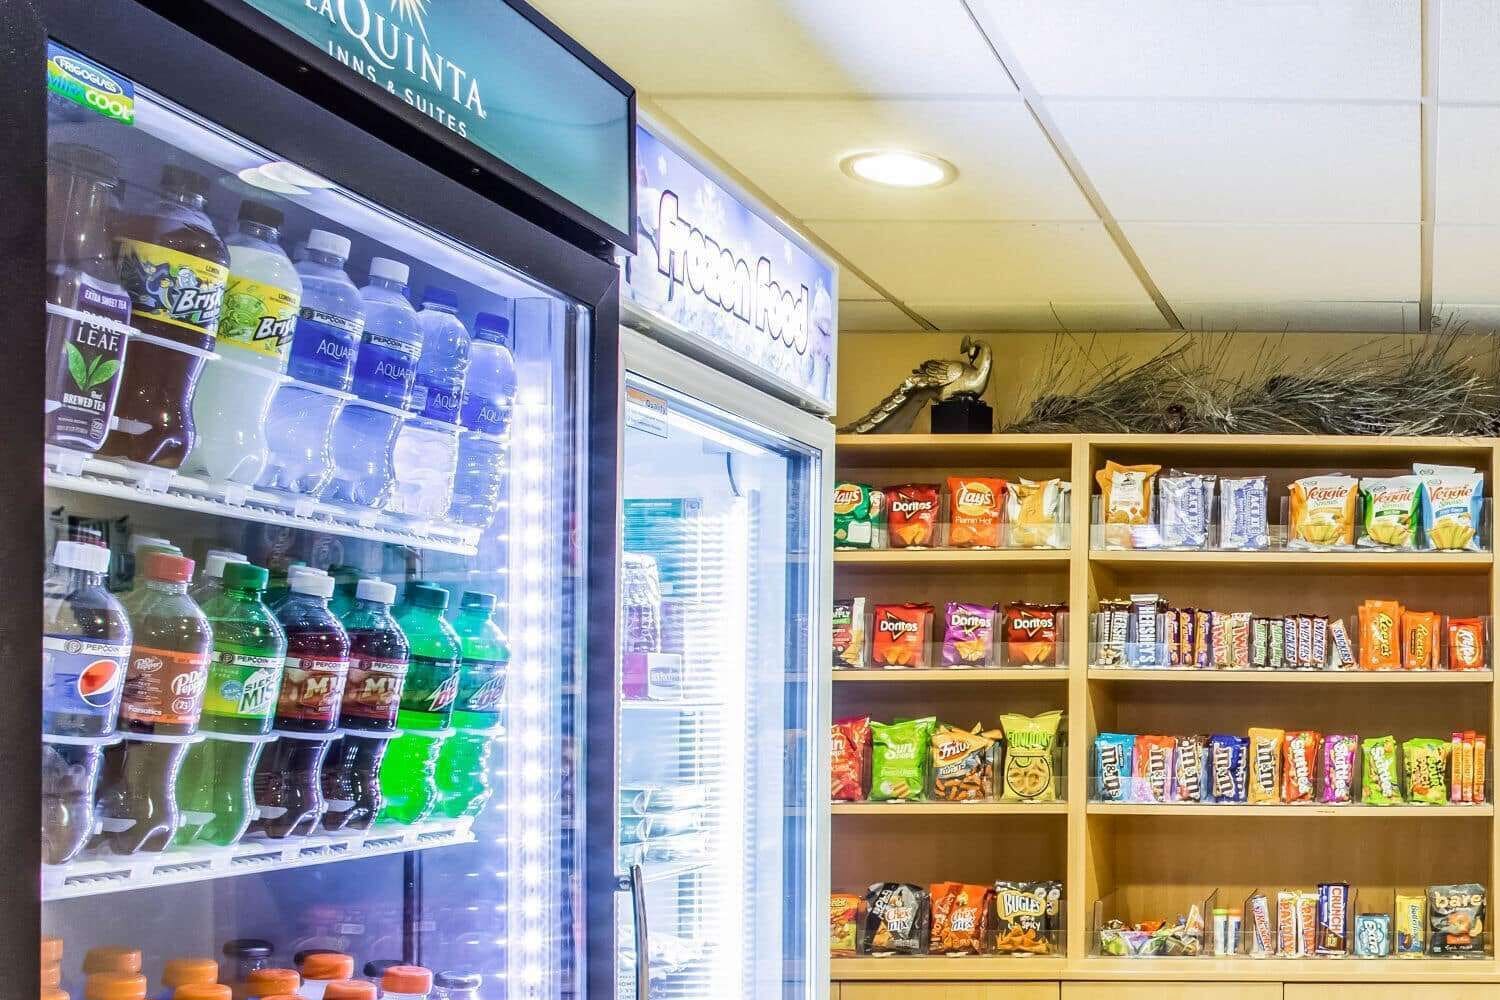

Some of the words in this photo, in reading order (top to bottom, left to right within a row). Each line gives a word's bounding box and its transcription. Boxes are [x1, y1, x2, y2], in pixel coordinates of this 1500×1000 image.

[338, 0, 487, 120] QUINTA
[328, 41, 377, 83] INNS
[386, 80, 395, 94] &
[404, 88, 468, 138] SUITES
[892, 500, 932, 514] Doritos
[880, 619, 918, 633] Doritos
[951, 614, 991, 628] Doritos
[1014, 616, 1054, 630] Doritos
[1003, 894, 1042, 915] BUGLES
[1433, 892, 1483, 909] bare
[1331, 887, 1343, 932] CRUNCH
